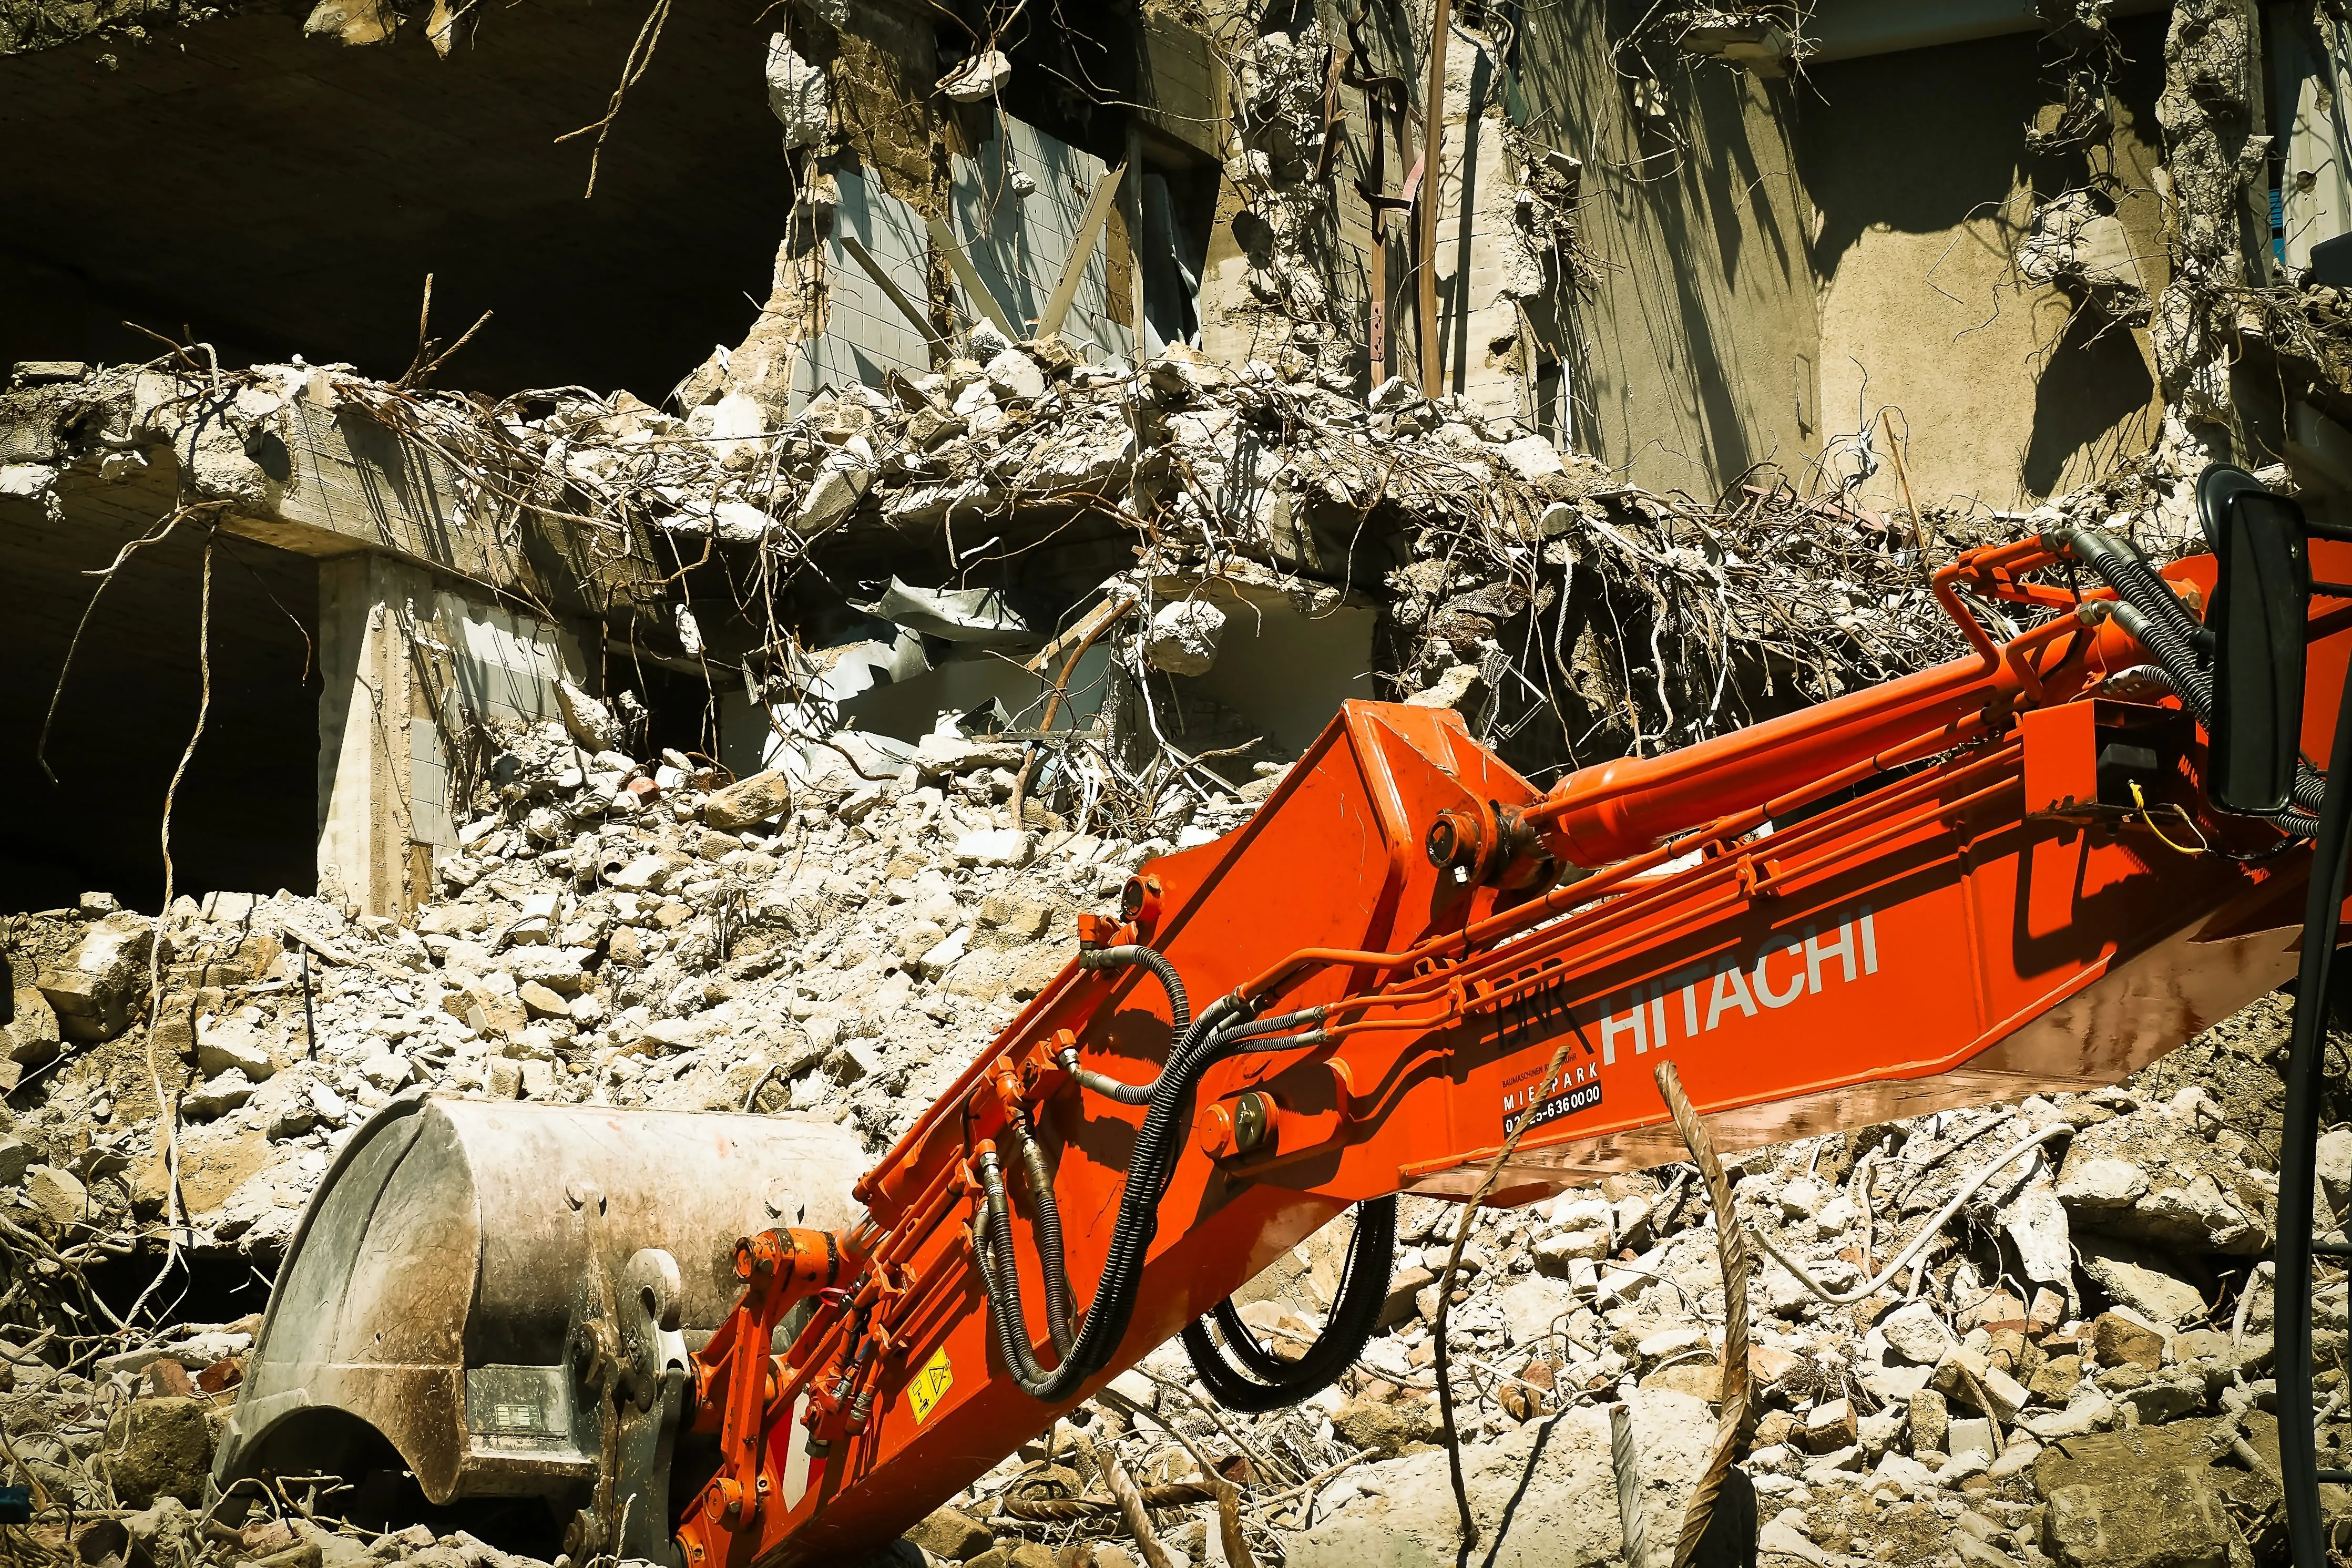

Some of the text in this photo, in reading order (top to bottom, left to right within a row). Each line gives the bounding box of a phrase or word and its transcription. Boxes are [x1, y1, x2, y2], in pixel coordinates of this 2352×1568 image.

[1599, 905, 1878, 1065] HITACHI
[1502, 1065, 1543, 1088] BAUMASCHINEN
[1504, 1061, 1598, 1111] MIEPARK
